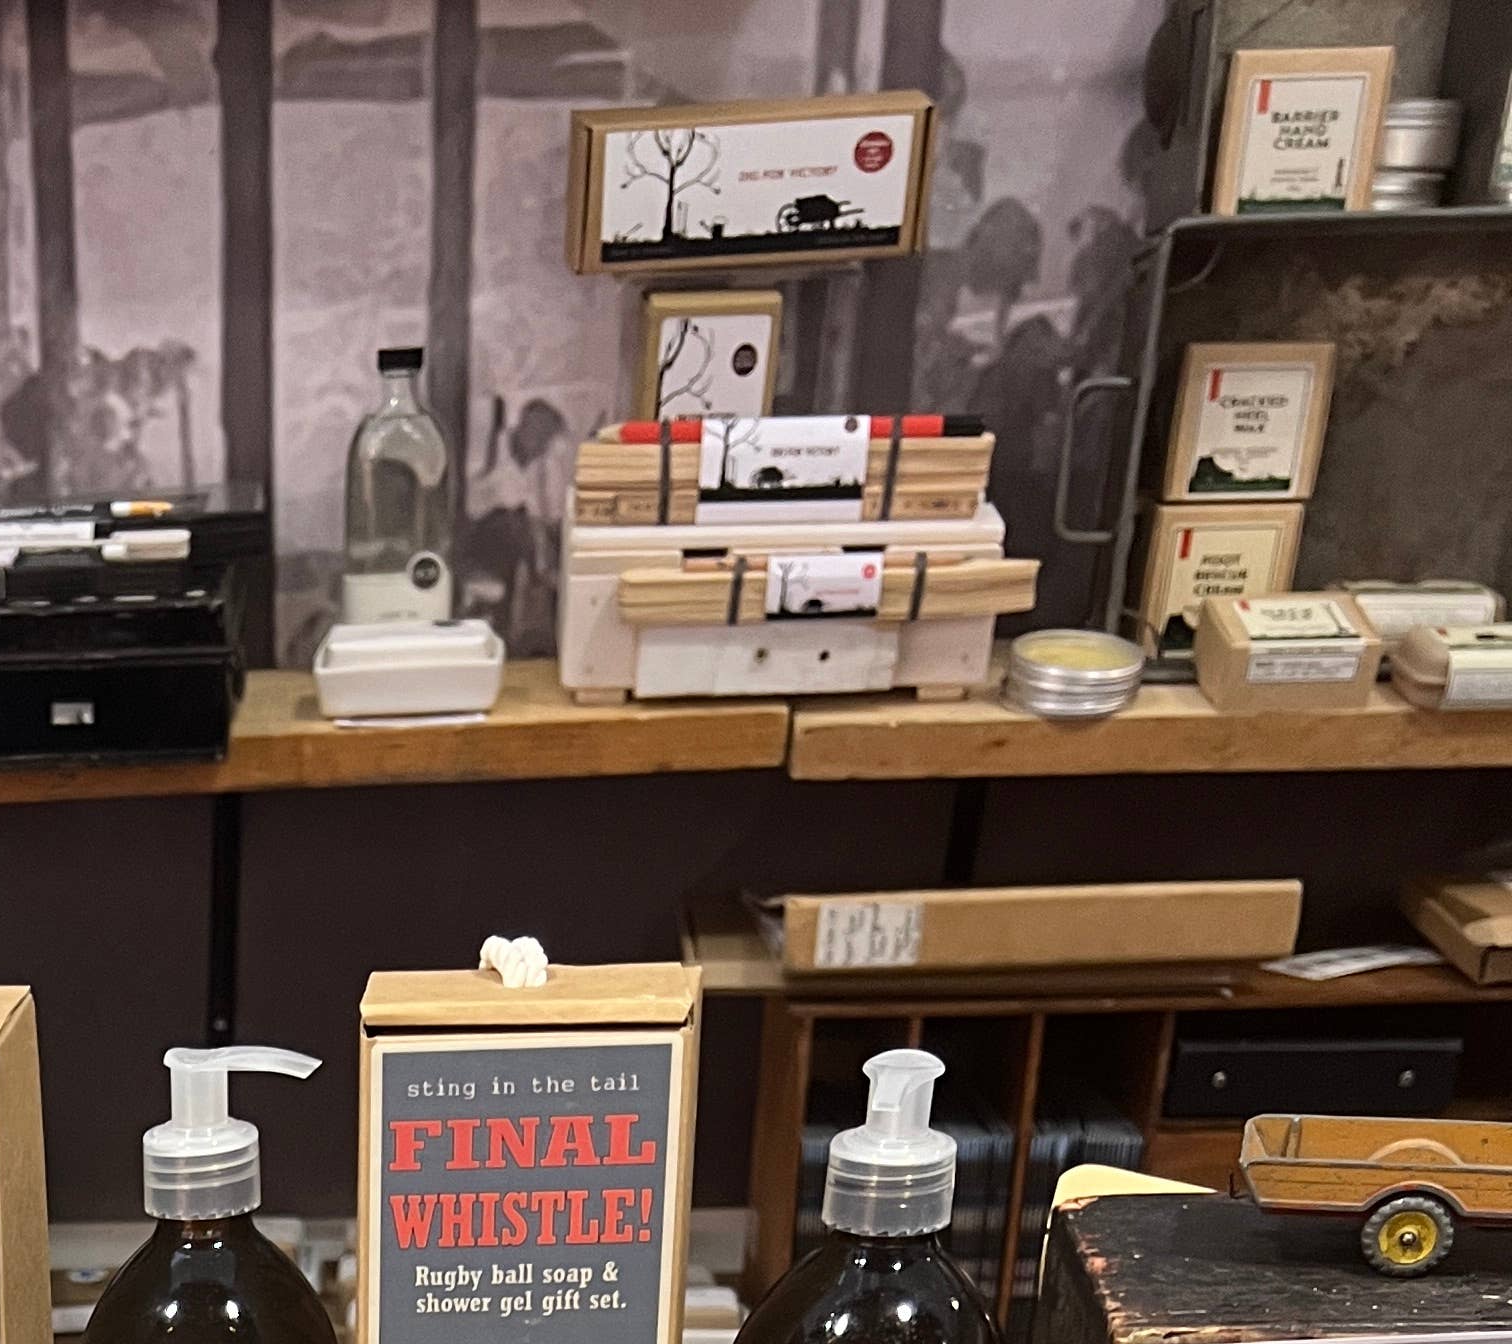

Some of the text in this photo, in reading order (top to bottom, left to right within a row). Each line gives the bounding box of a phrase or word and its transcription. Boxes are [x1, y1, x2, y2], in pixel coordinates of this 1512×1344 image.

[408, 1073, 639, 1099] sting in the tail
[389, 1113, 657, 1171] FINAL
[389, 1188, 653, 1249] WHISTLE!
[415, 1261, 618, 1291] Rugby ball soap &
[416, 1289, 626, 1317] shower gel gift set.
